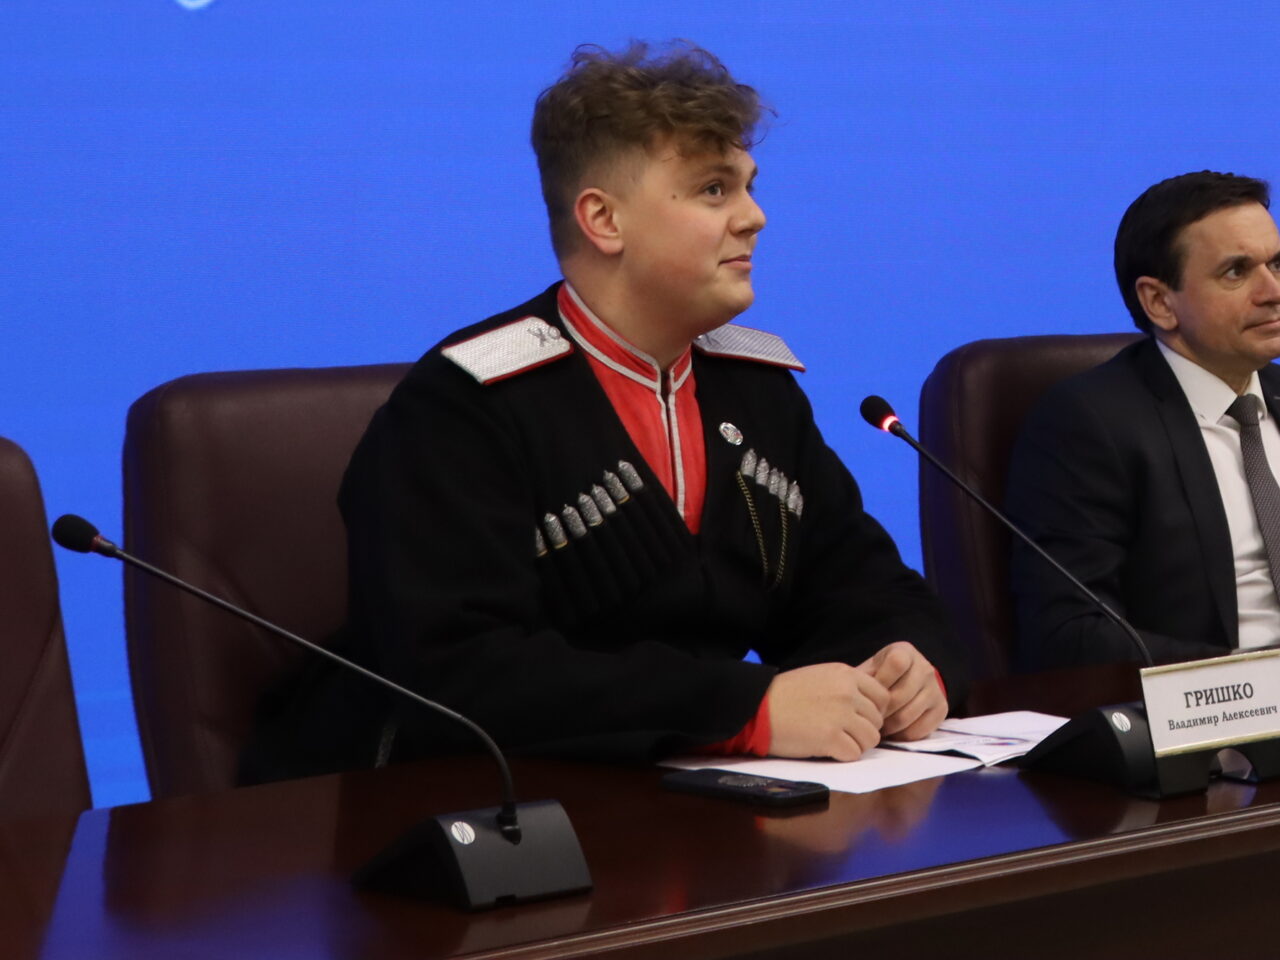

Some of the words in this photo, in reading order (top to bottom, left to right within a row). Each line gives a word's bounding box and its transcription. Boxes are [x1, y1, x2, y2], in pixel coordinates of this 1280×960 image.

[1184, 683, 1254, 708] ГРИШКО
[1169, 715, 1219, 730] Владимир
[1222, 705, 1277, 722] Алексеевич
